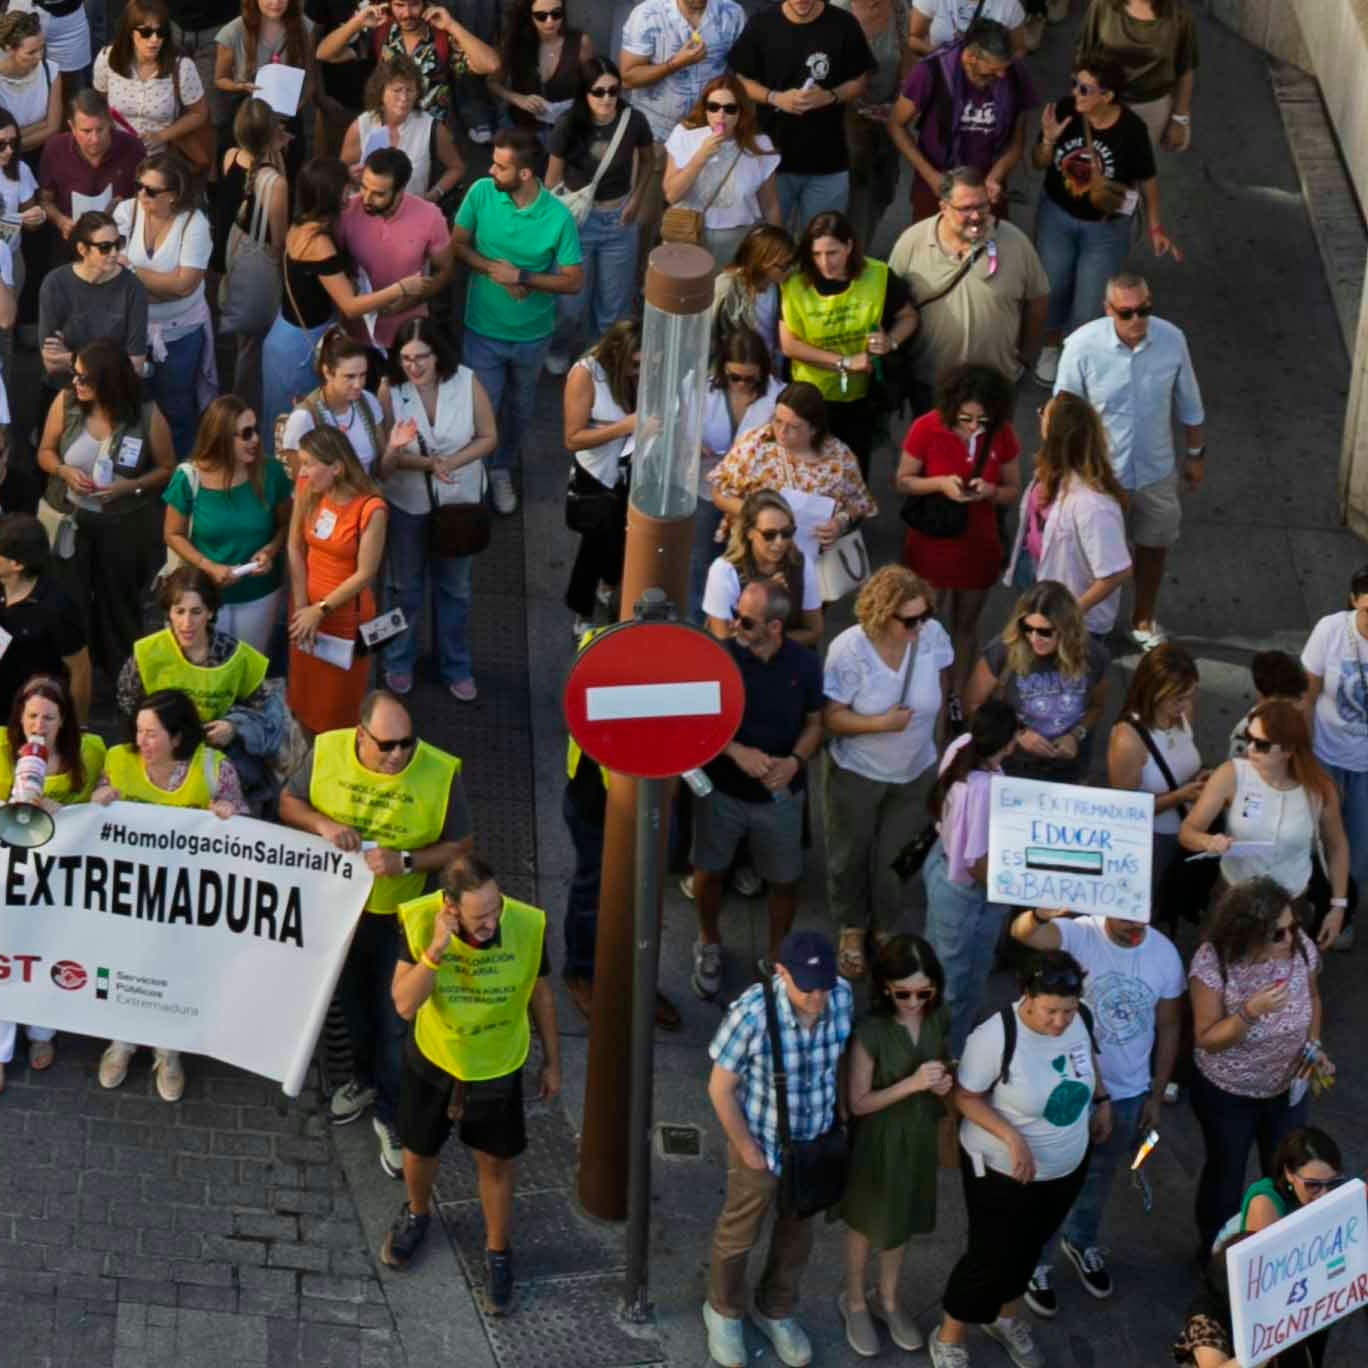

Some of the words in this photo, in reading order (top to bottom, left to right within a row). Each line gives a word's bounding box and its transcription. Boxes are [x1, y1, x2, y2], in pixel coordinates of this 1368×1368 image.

[1039, 793, 1146, 820] EXTREMADURA
[99, 821, 354, 881] #HomologaciónSalarialYa
[1032, 820, 1112, 849] EDUCAR
[5, 844, 304, 948] EXTREMADURA
[1020, 873, 1117, 906] BARATO
[1247, 1215, 1359, 1302] HOMOLOGAR
[1285, 1277, 1309, 1306] ES
[1251, 1273, 1368, 1358] DIGNIFICAR
